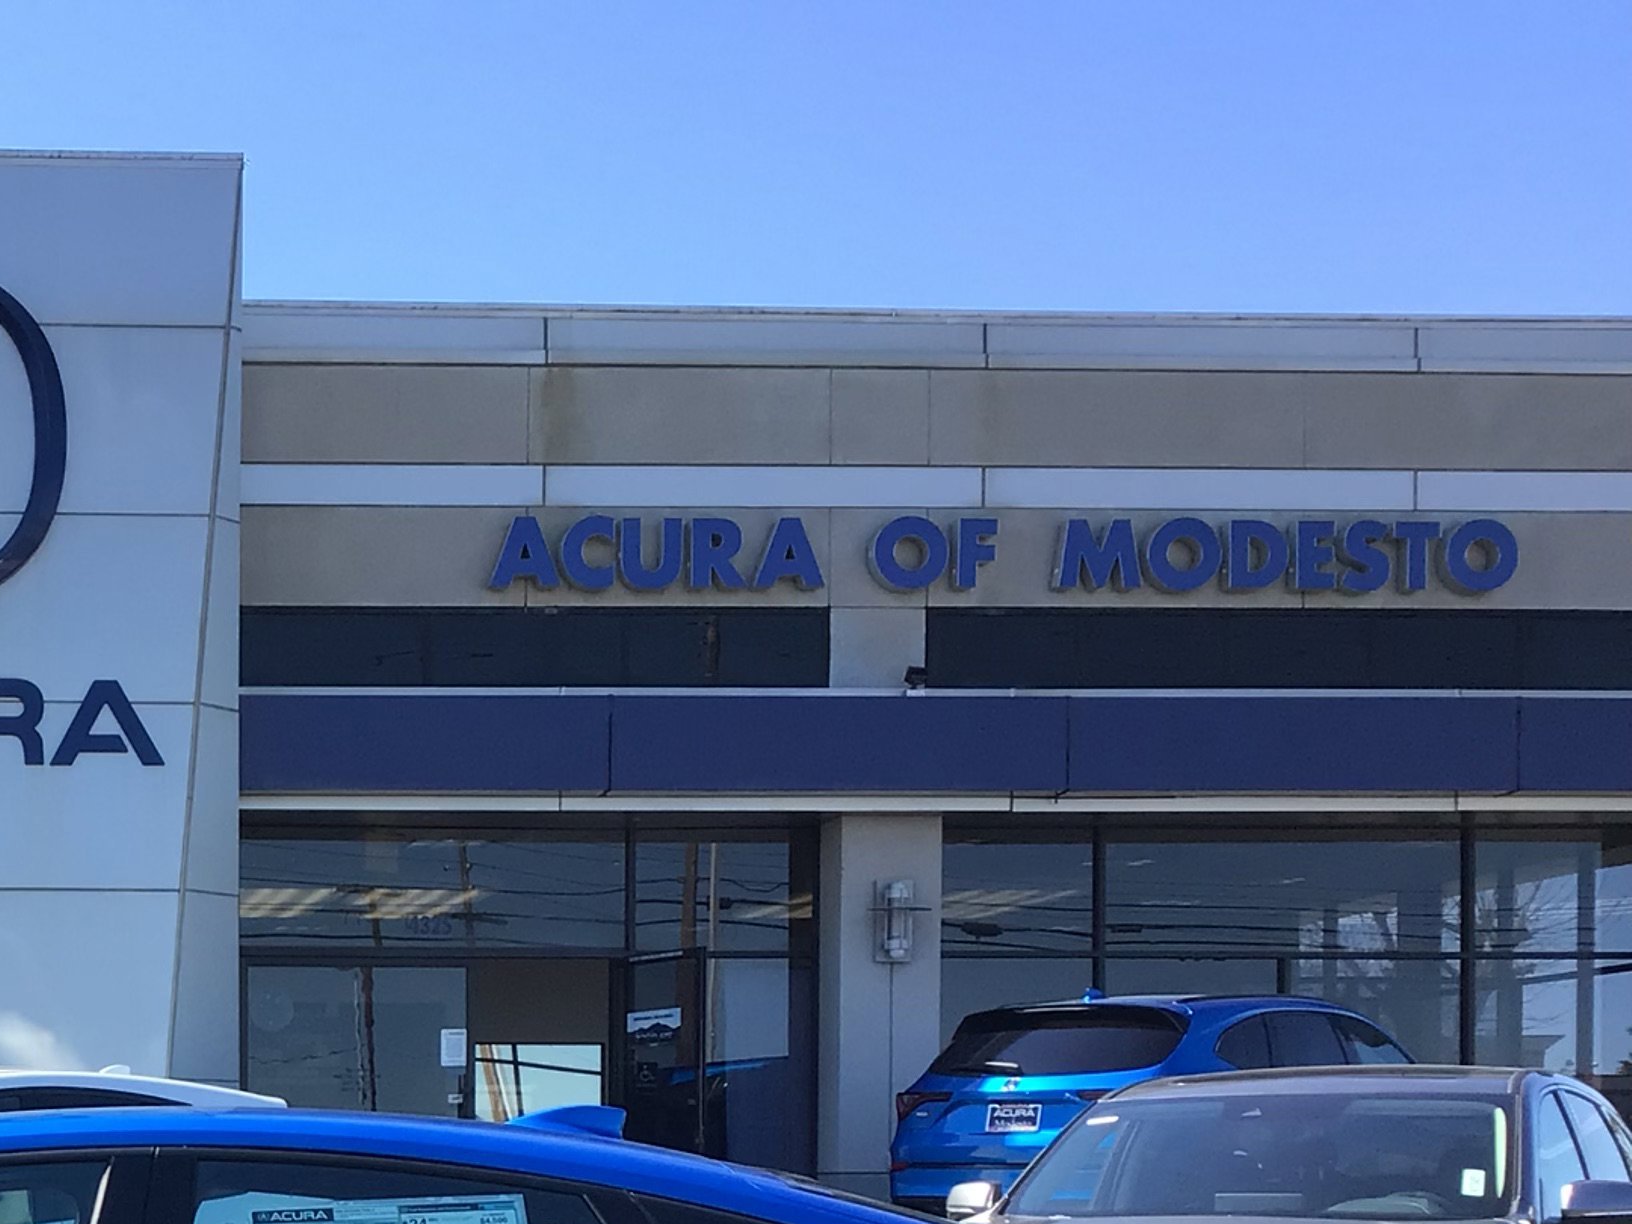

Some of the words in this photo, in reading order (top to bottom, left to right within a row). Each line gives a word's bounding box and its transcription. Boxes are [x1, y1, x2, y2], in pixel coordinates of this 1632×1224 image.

[488, 515, 825, 592] ACURA
[870, 515, 999, 590] OF
[1053, 516, 1518, 592] MODESTO
[993, 1108, 1036, 1118] ACURA
[269, 1209, 329, 1222] ACURA
